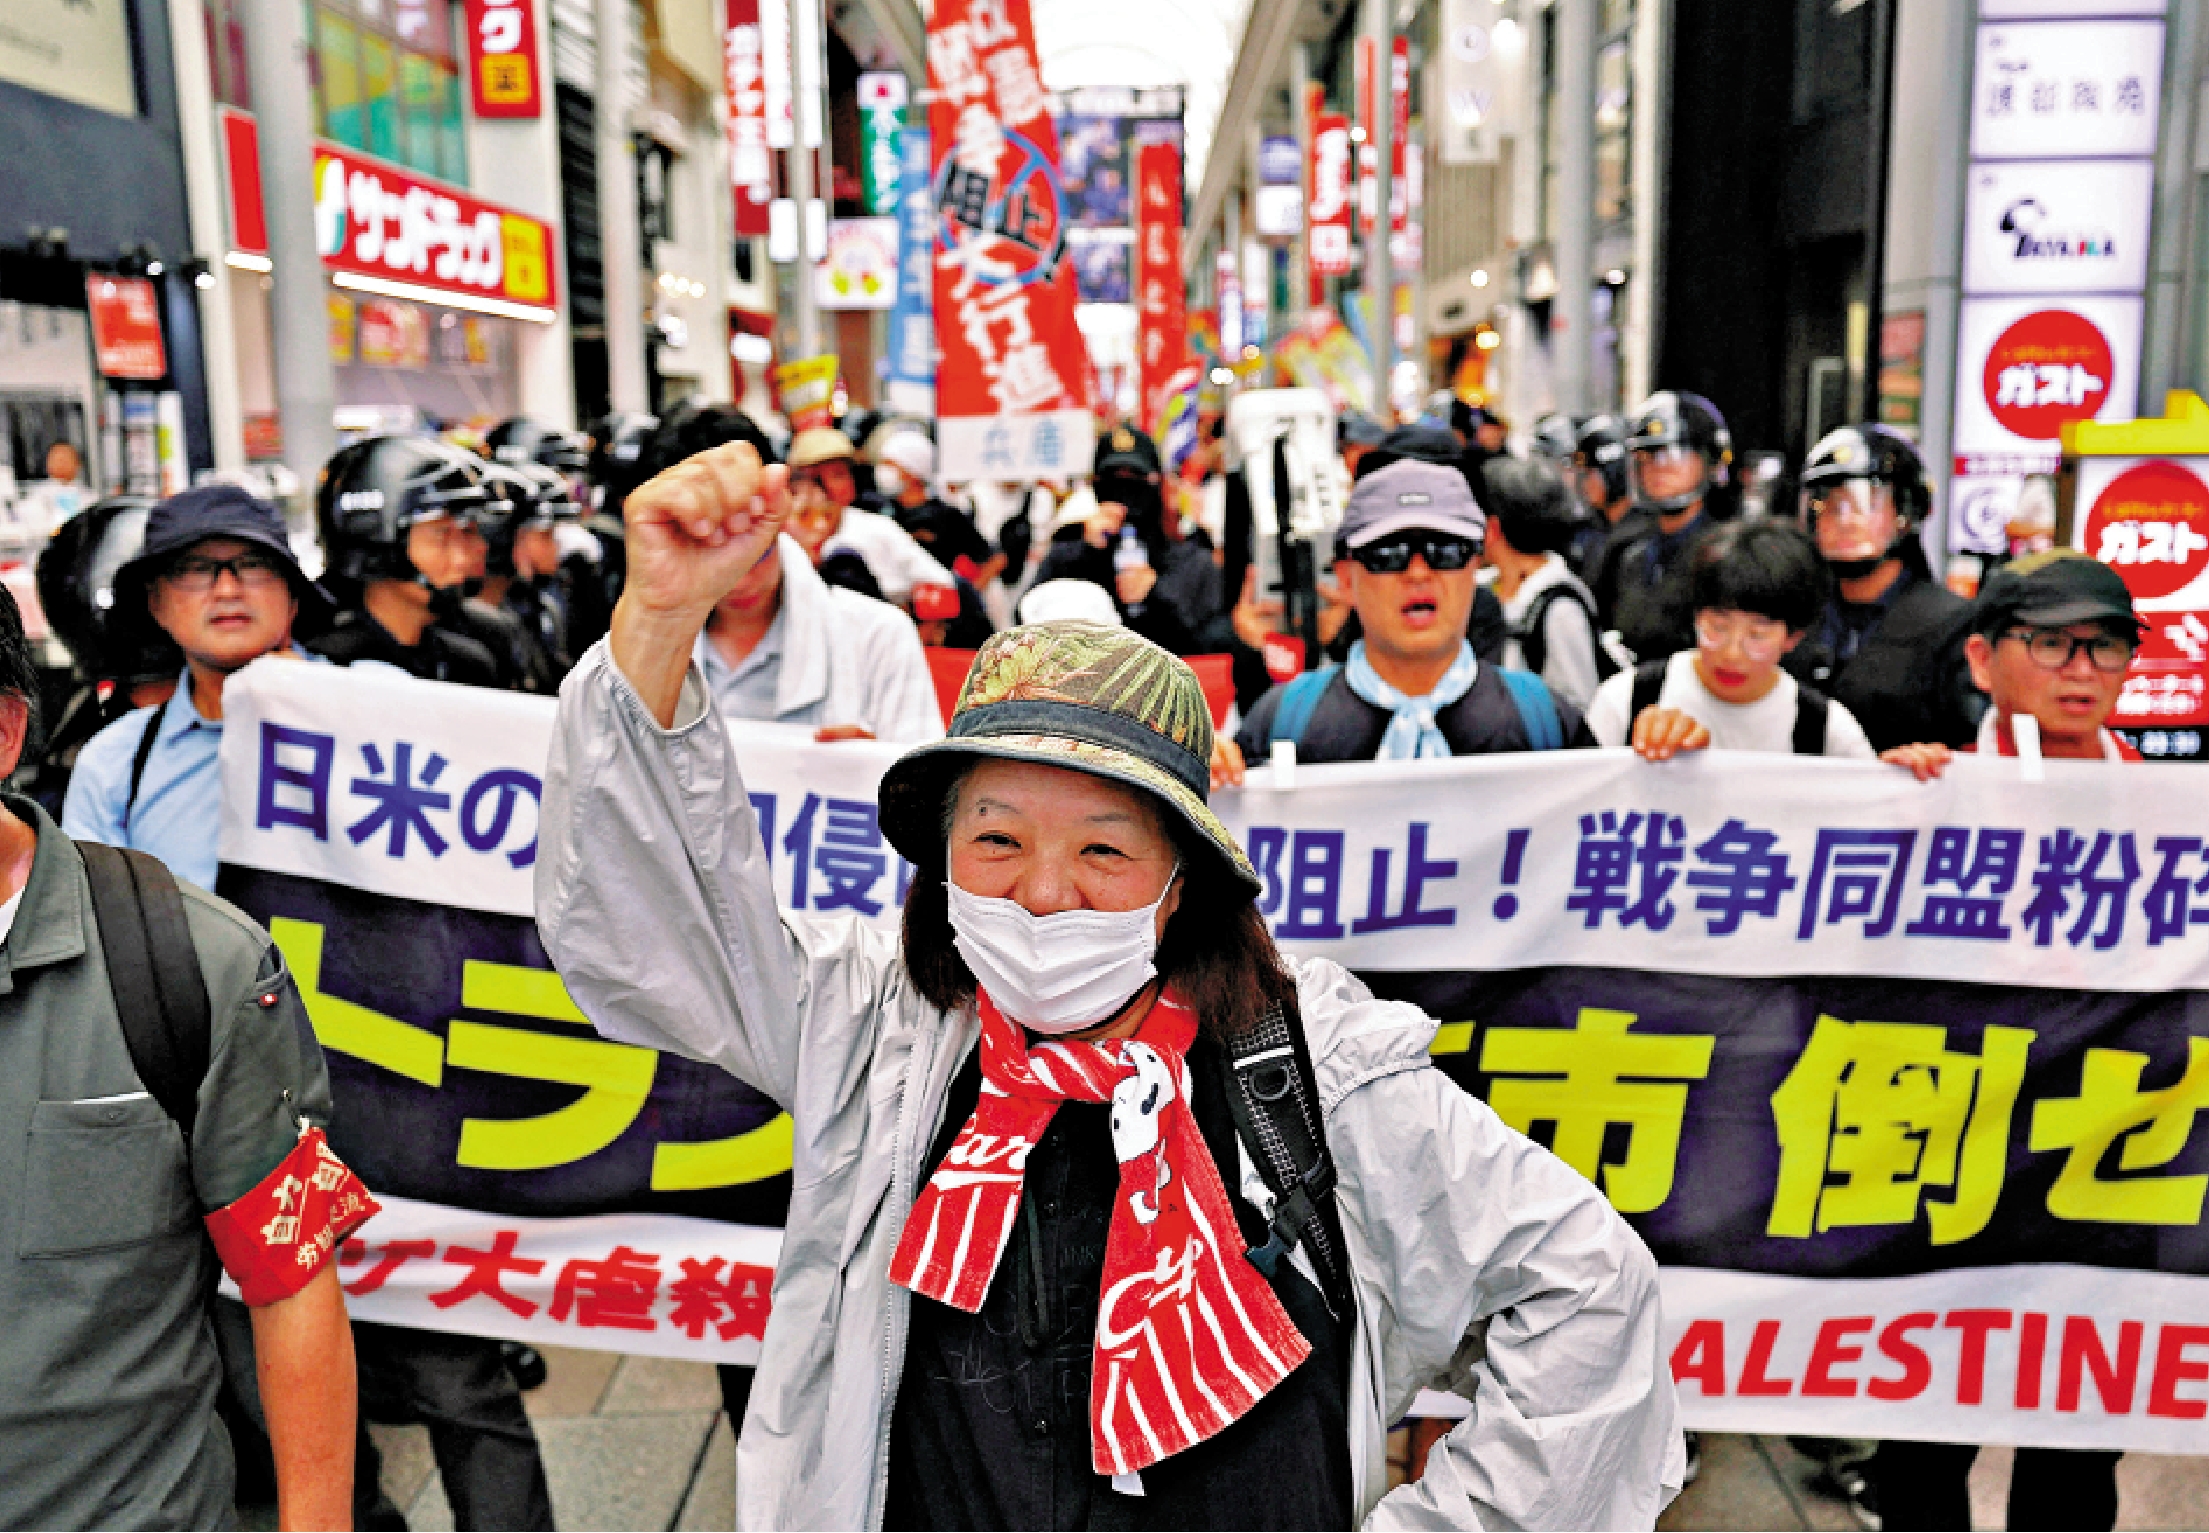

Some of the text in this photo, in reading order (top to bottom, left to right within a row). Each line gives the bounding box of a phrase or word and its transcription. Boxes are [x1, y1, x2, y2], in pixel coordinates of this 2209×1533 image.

[478, 0, 525, 54] グ
[347, 168, 502, 291] サンドラッグ
[1995, 360, 2105, 409] ガスト
[2095, 519, 2209, 566] ガスト
[1669, 1307, 2209, 1420] ALESTINE
